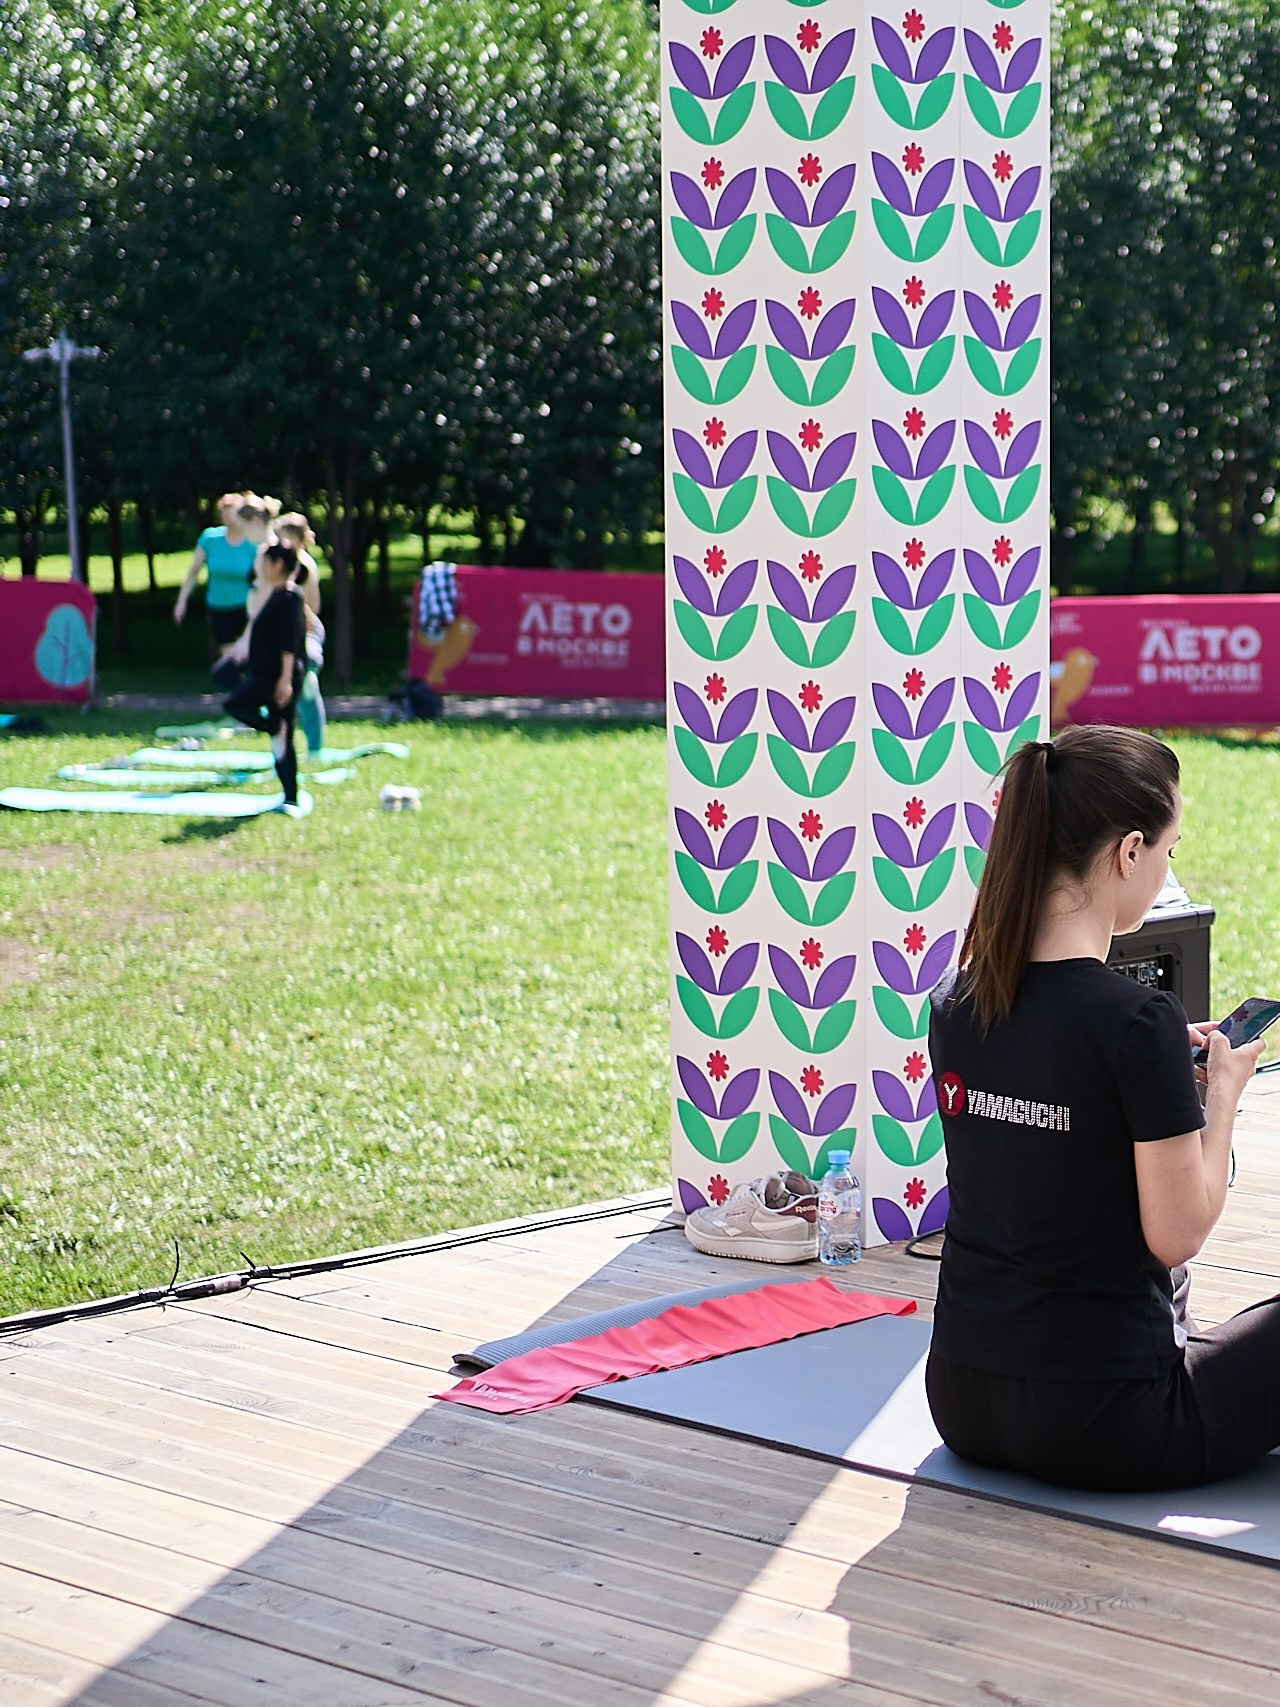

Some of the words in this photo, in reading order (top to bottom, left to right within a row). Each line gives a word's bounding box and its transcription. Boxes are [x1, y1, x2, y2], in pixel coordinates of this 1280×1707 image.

[521, 603, 631, 636] ЛЕТО
[517, 636, 533, 655] В
[537, 638, 629, 656] МОСКВЕ
[1140, 625, 1262, 661] ЛЕТО
[1140, 663, 1156, 683] В
[1162, 663, 1261, 683] МОСКВЕ
[943, 1082, 958, 1109] Y
[966, 1088, 1070, 1132] YAMAGUCHI
